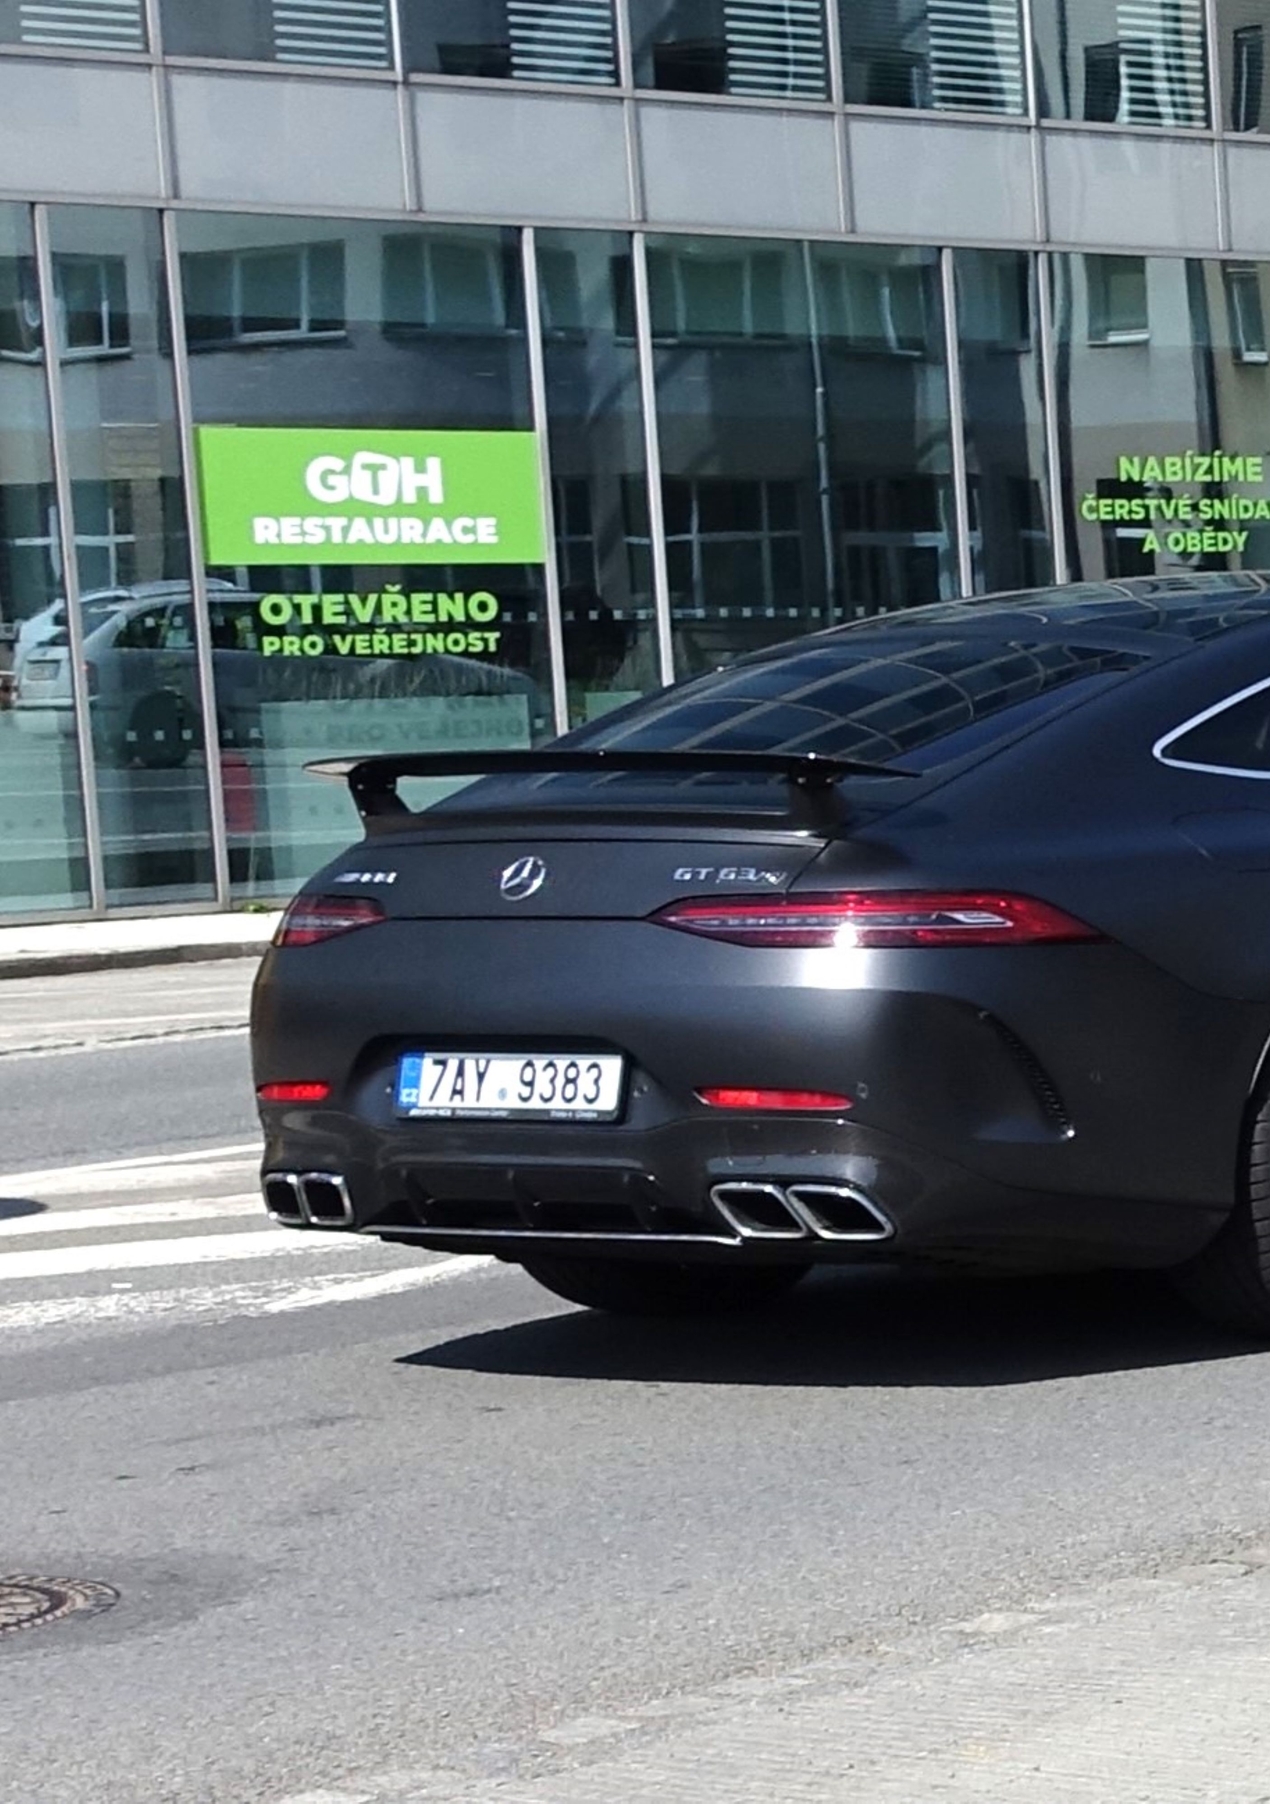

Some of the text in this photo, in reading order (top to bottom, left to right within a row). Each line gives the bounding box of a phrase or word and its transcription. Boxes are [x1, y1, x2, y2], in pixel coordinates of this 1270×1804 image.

[305, 451, 444, 506] GTH
[1119, 450, 1263, 482] NABÍZÍME
[1081, 493, 1193, 521] ČERSTVÉ
[252, 516, 499, 545] RESTAURACE
[1142, 525, 1248, 554] A OBĚDY
[259, 584, 498, 626] OTEVŘENO
[262, 627, 500, 657] PRO VEŘEJNOST
[673, 867, 714, 880] GT
[428, 1059, 602, 1104] 7AY 9383
